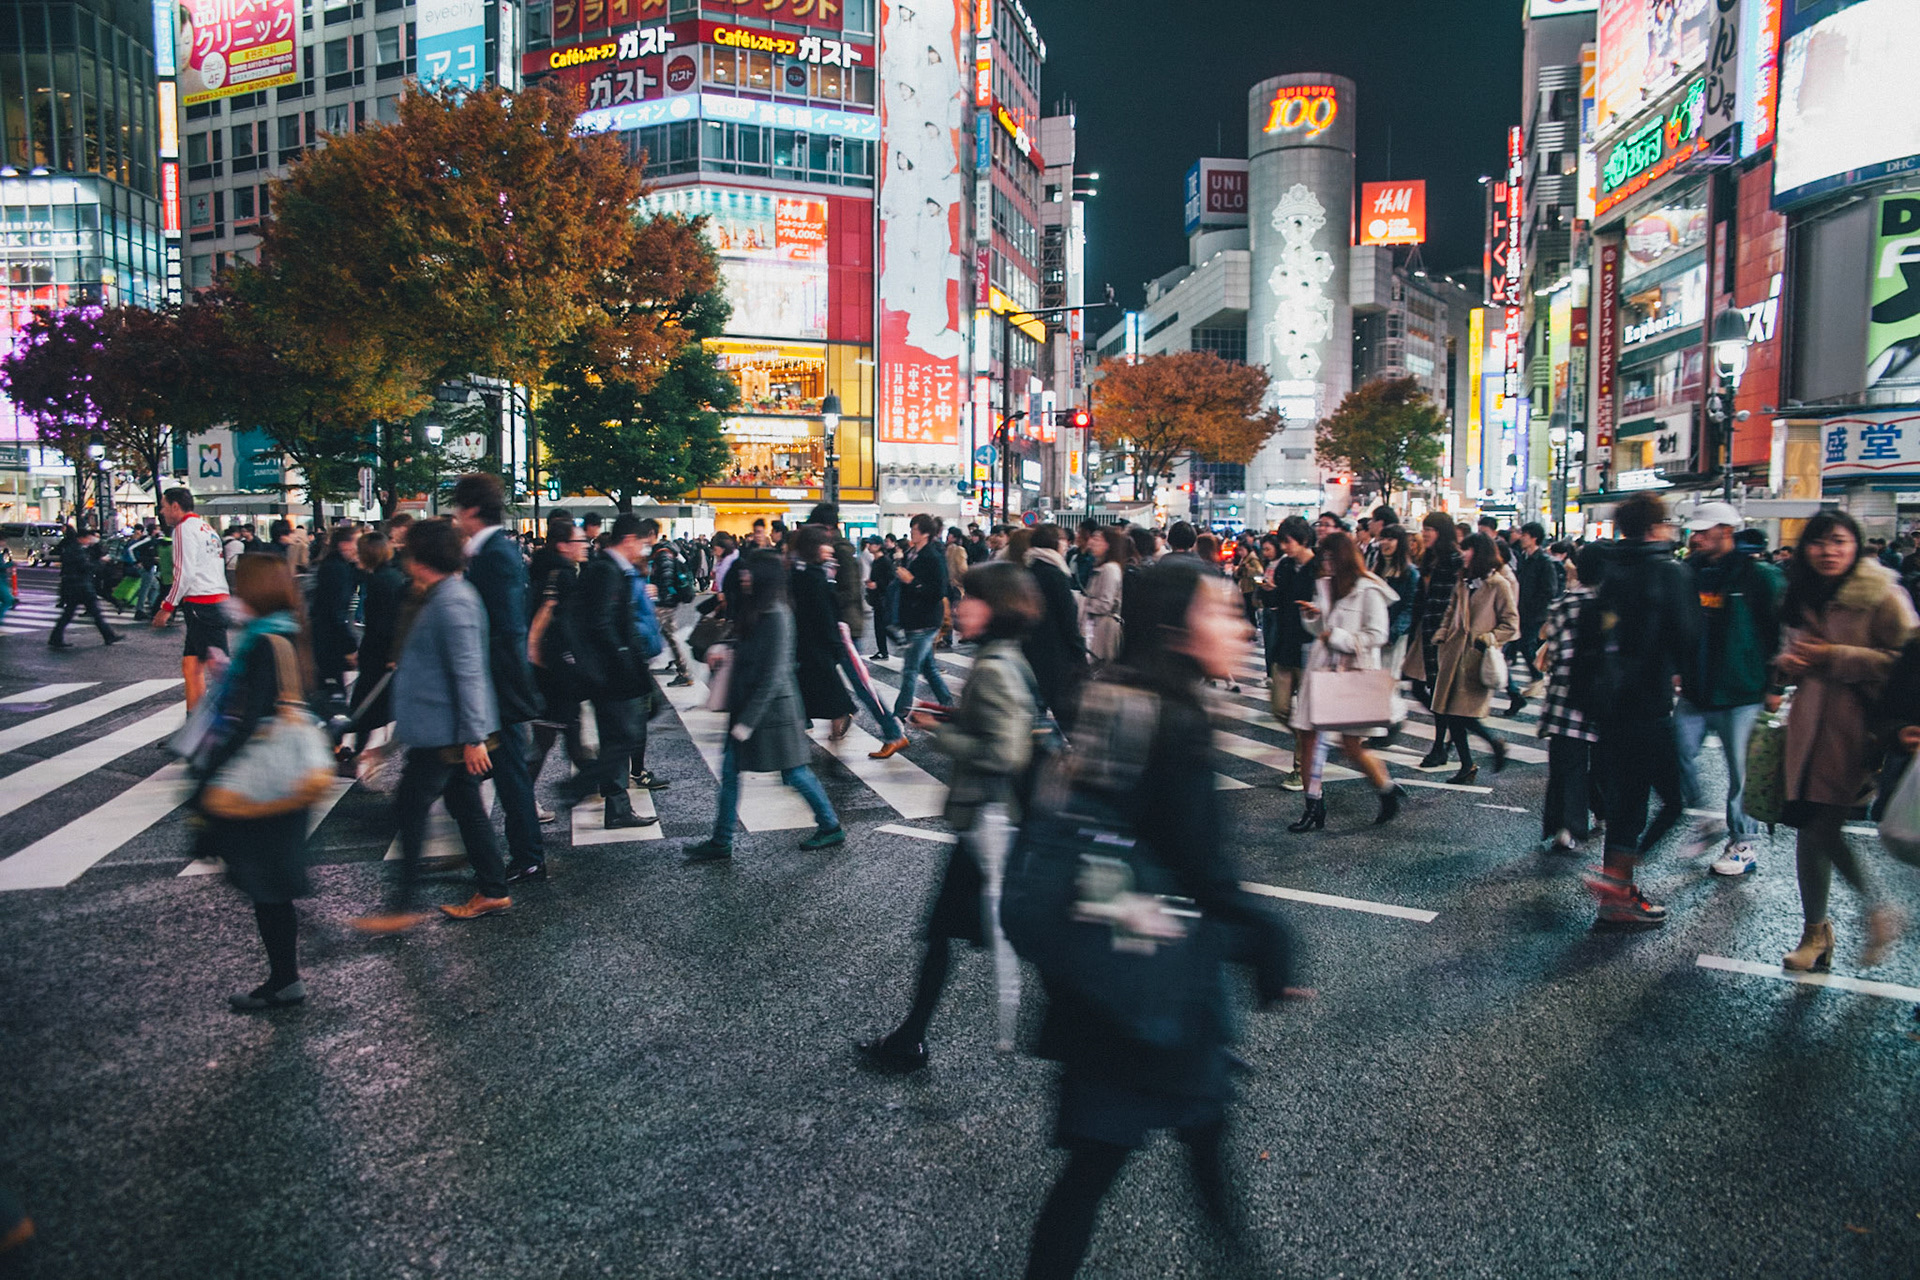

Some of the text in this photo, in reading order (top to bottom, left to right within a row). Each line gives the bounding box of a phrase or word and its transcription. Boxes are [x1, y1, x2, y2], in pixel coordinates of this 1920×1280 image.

[196, 10, 292, 56] クリニック
[619, 26, 675, 60] ガスト
[798, 36, 862, 68] ガスト
[590, 69, 657, 109] ガスト
[1277, 85, 1335, 98] SHIBUYA
[1262, 96, 1338, 139] 109
[1886, 158, 1915, 172] DHC
[1212, 175, 1241, 190] UNI
[1212, 193, 1244, 210] QLO
[1374, 188, 1412, 213] H&M
[33, 233, 93, 246] CITY
